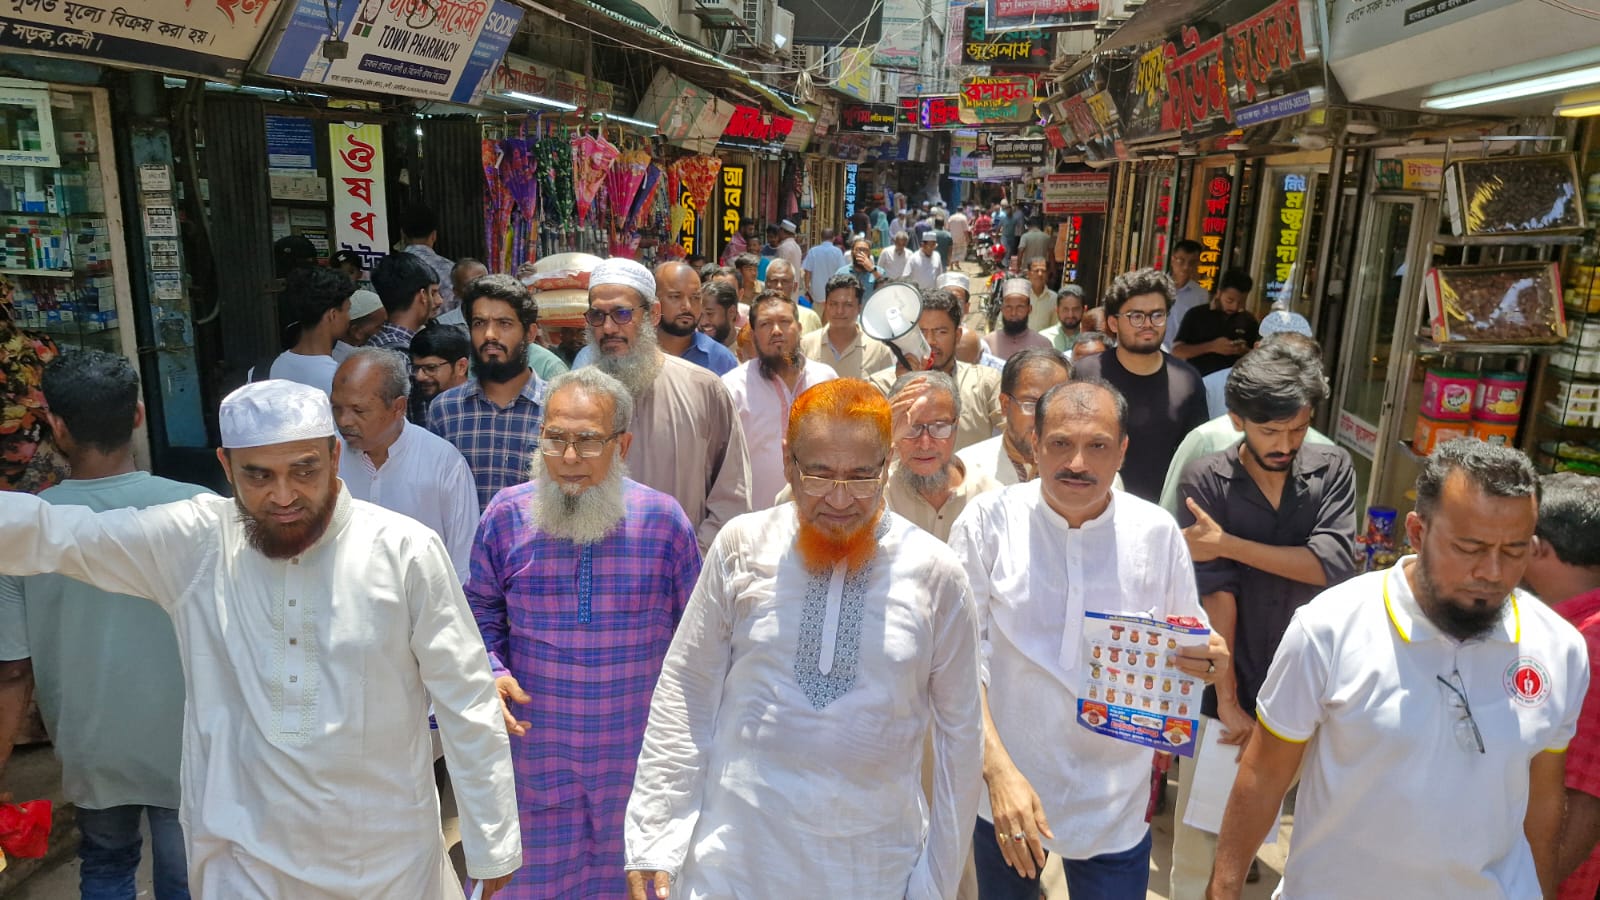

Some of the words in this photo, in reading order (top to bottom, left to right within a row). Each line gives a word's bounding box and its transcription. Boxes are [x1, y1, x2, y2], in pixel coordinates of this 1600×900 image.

[64, 1, 106, 24] মূল্যে
[108, 6, 154, 33] বিক্রয়
[158, 20, 186, 39] করা
[377, 24, 412, 53] TOWN
[408, 32, 460, 62] PHARMACY
[339, 134, 377, 241] ঔষধ
[723, 167, 744, 242] আবেদী
